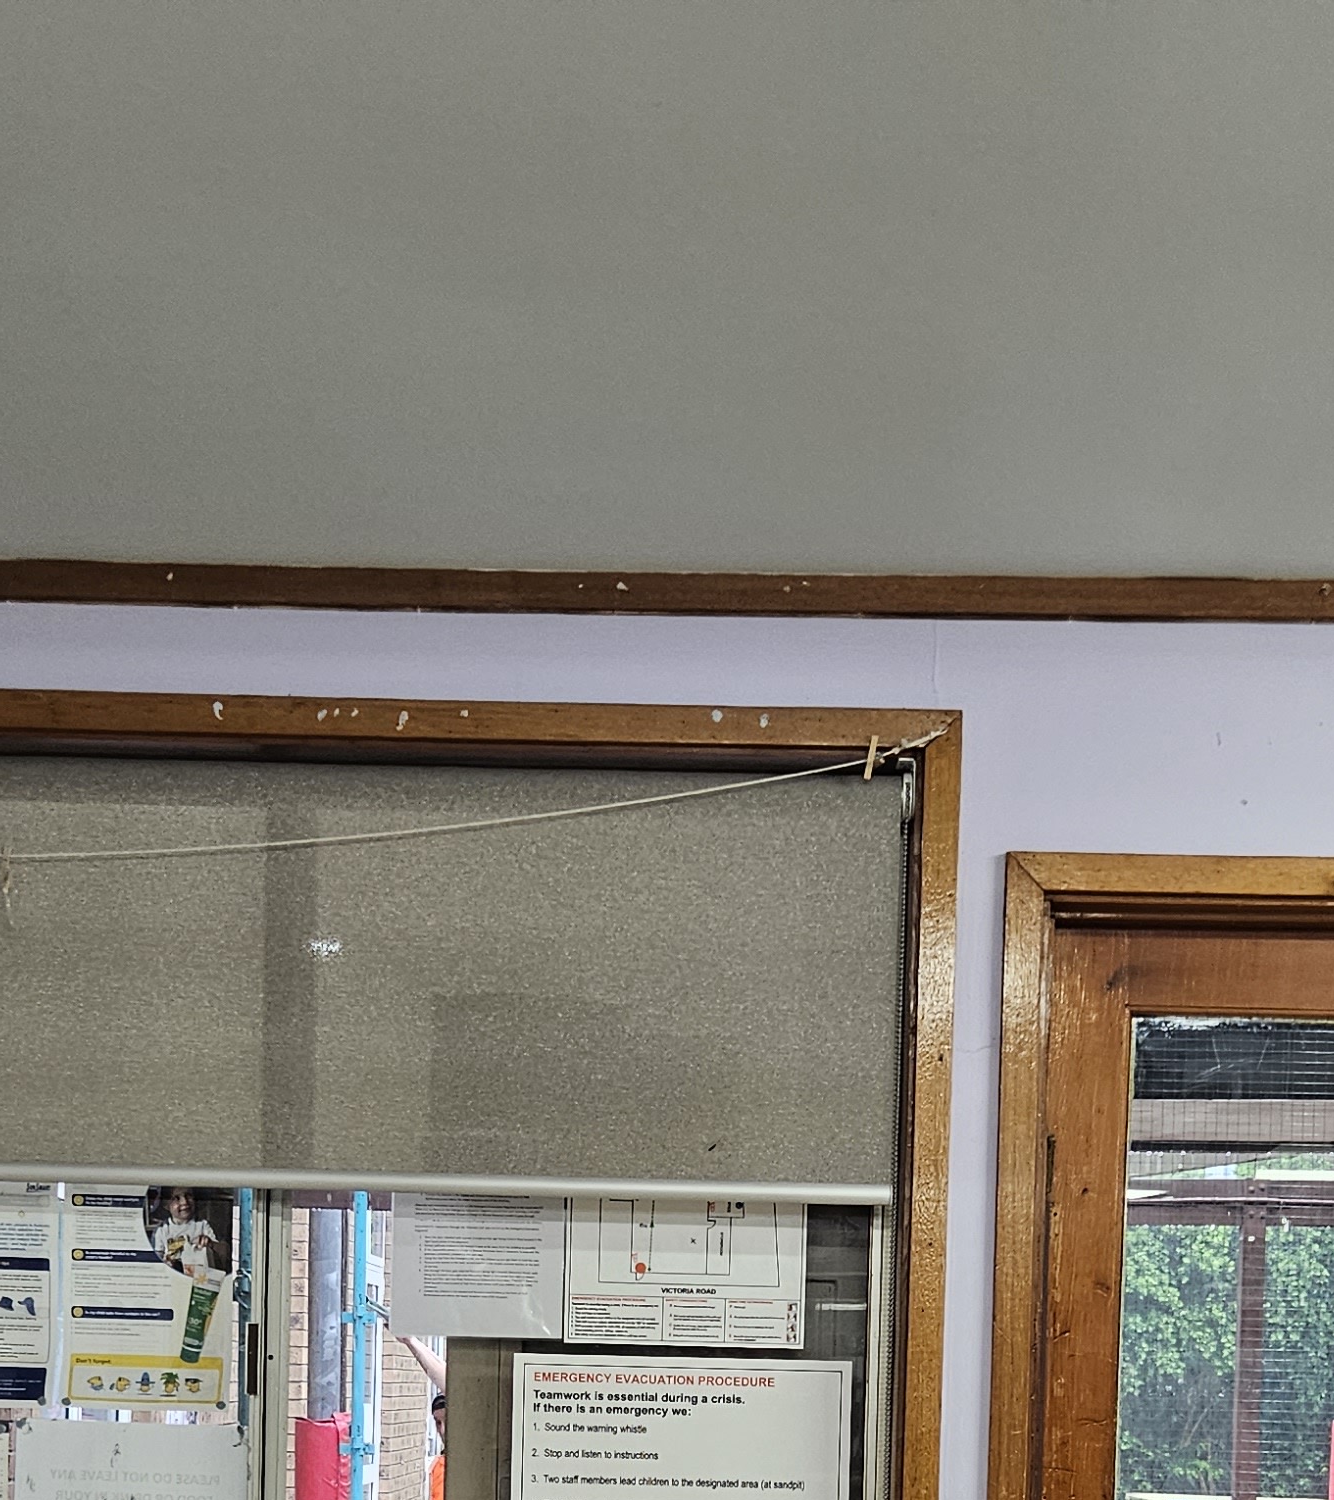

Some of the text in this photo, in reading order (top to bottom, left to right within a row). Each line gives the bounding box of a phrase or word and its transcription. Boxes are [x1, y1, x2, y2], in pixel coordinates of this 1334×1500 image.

[534, 1371, 774, 1387] EMERGENCY EVACUATION PROCEDURE
[533, 1389, 591, 1400] Teamwork
[594, 1391, 603, 1400] is
[607, 1391, 657, 1402] essential
[661, 1392, 698, 1405] during
[711, 1393, 744, 1404] crisis.
[533, 1402, 540, 1412] If
[543, 1403, 572, 1413] there
[576, 1404, 585, 1413] is
[606, 1406, 668, 1418] emergency
[672, 1407, 691, 1416] we:
[544, 1422, 570, 1432] Sound
[572, 1423, 585, 1432] the
[544, 1448, 562, 1459] Stop
[564, 1449, 579, 1458] and
[581, 1449, 601, 1458] listen
[604, 1451, 612, 1459] to
[614, 1450, 658, 1460] instructions
[543, 1474, 559, 1483] Two
[562, 1474, 578, 1484] staff
[580, 1476, 617, 1485] members
[619, 1476, 636, 1485] lead
[638, 1477, 669, 1486] children
[671, 1478, 679, 1486] to
[681, 1478, 693, 1487] the
[695, 1478, 739, 1490] designated
